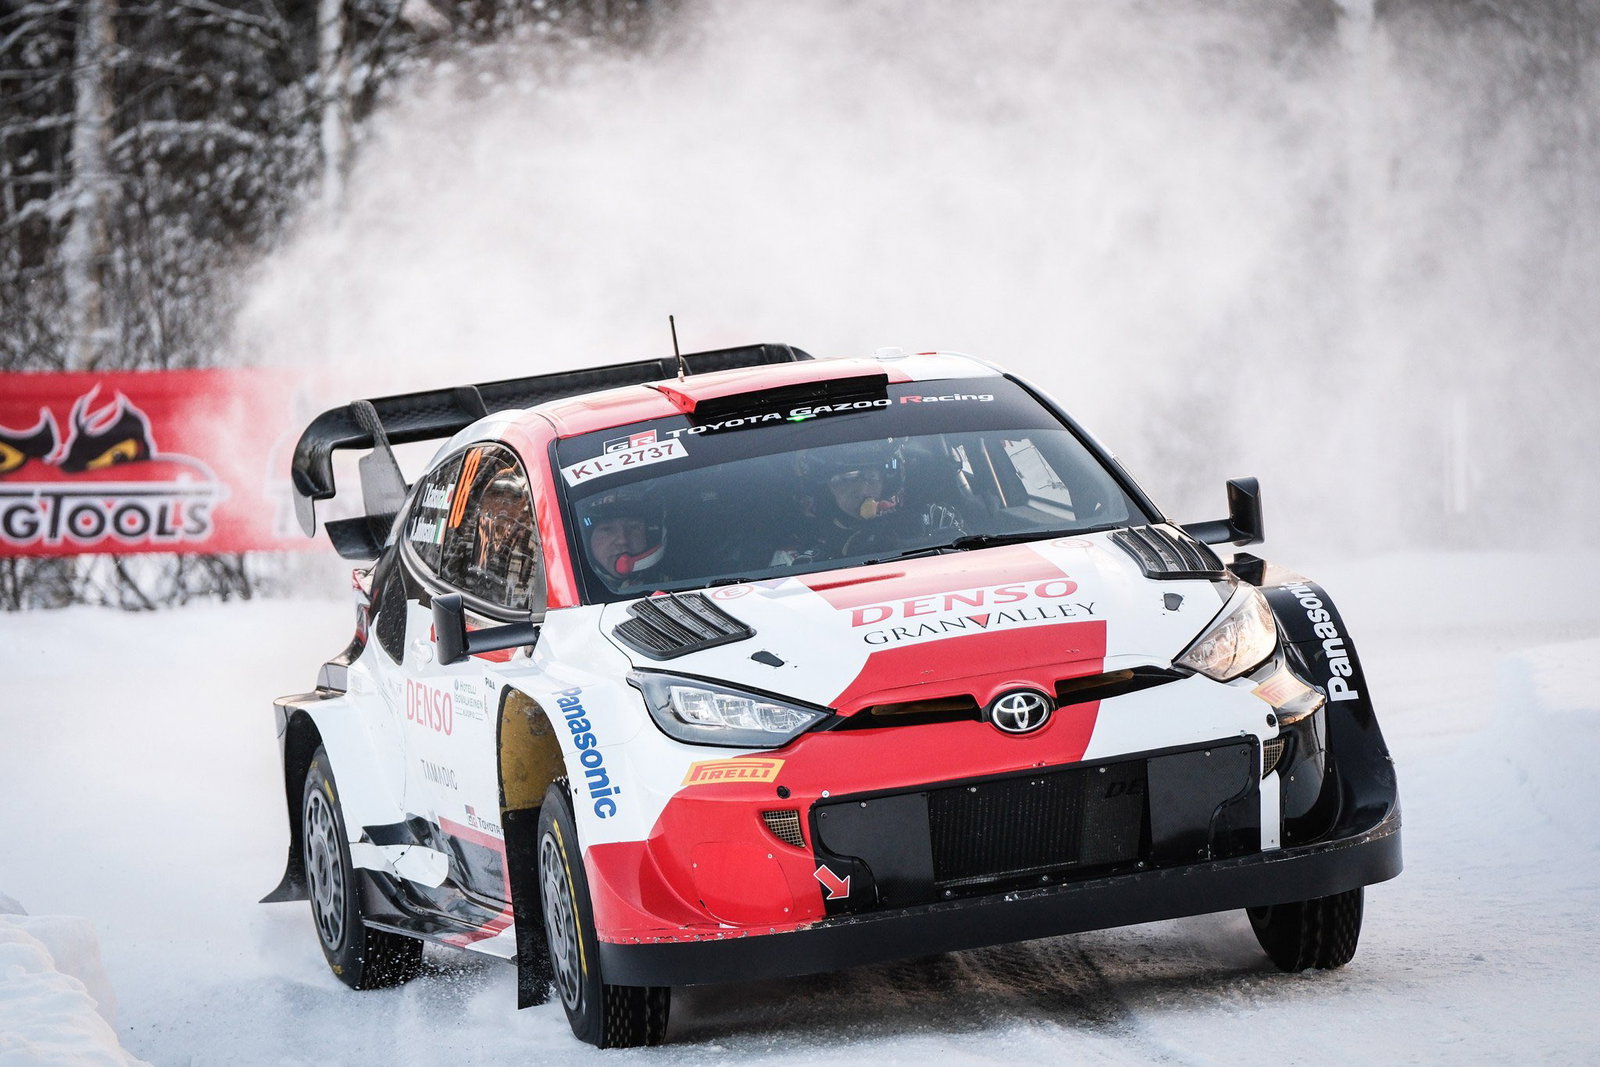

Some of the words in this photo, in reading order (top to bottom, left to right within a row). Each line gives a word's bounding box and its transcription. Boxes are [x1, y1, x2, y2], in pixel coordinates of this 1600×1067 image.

[666, 412, 782, 438] TOYOTA
[790, 399, 892, 418] GAZOO
[900, 393, 994, 405] Racing
[851, 579, 1079, 628] DENSO
[863, 601, 1097, 645] GRANVALLEY
[406, 679, 453, 736] DENSO
[552, 686, 621, 819] Panasonic
[690, 762, 776, 782] PIRELLI
